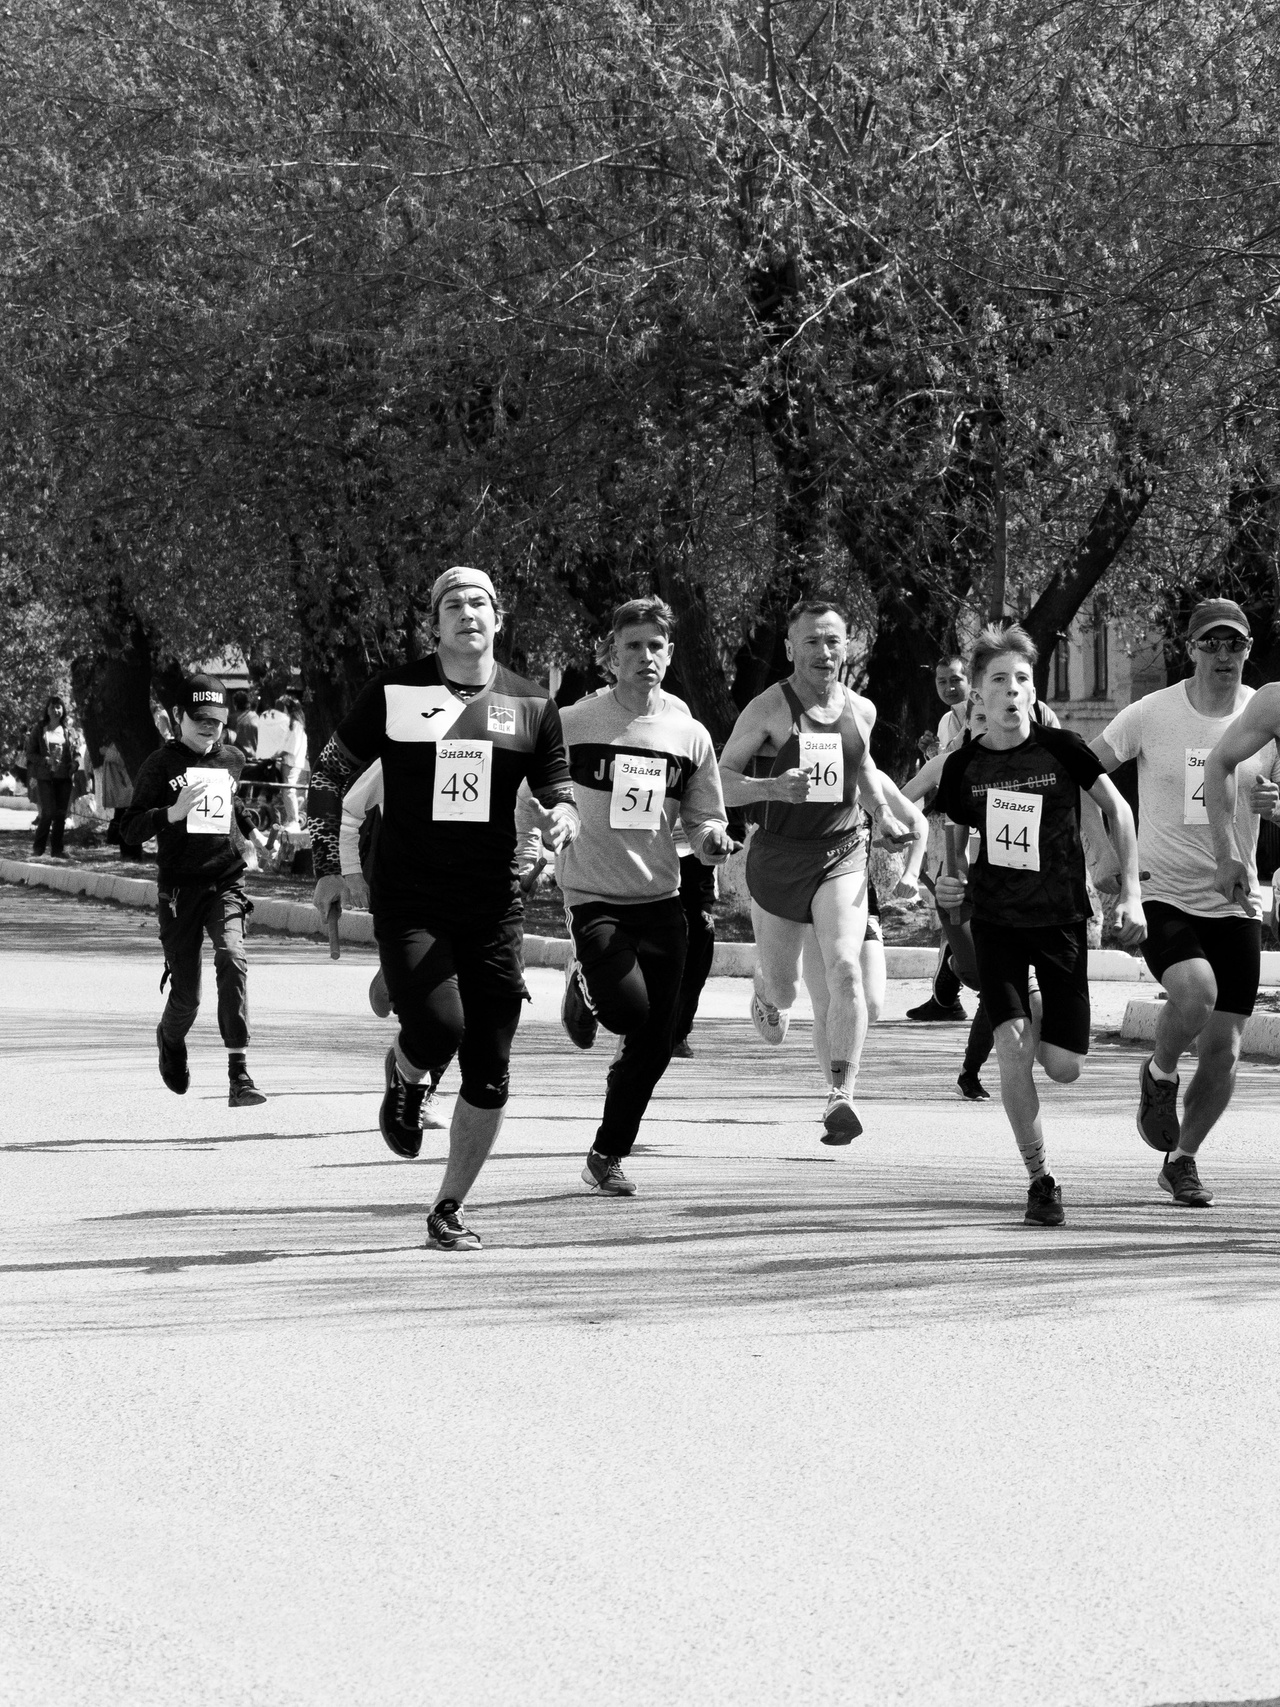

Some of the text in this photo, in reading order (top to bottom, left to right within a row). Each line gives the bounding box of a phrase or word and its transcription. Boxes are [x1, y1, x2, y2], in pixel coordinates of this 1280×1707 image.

[192, 691, 224, 704] RUSSIA
[439, 749, 483, 759] Знамя
[804, 741, 837, 750] Знамя
[621, 763, 662, 777] Знамя
[810, 761, 837, 786] 46
[441, 772, 479, 802] 48
[1027, 773, 1057, 789] CLUB
[621, 787, 654, 812] 51
[1191, 782, 1207, 807] 4
[196, 795, 225, 819] 42
[992, 798, 1035, 813] Знамя
[996, 824, 1031, 853] 44
